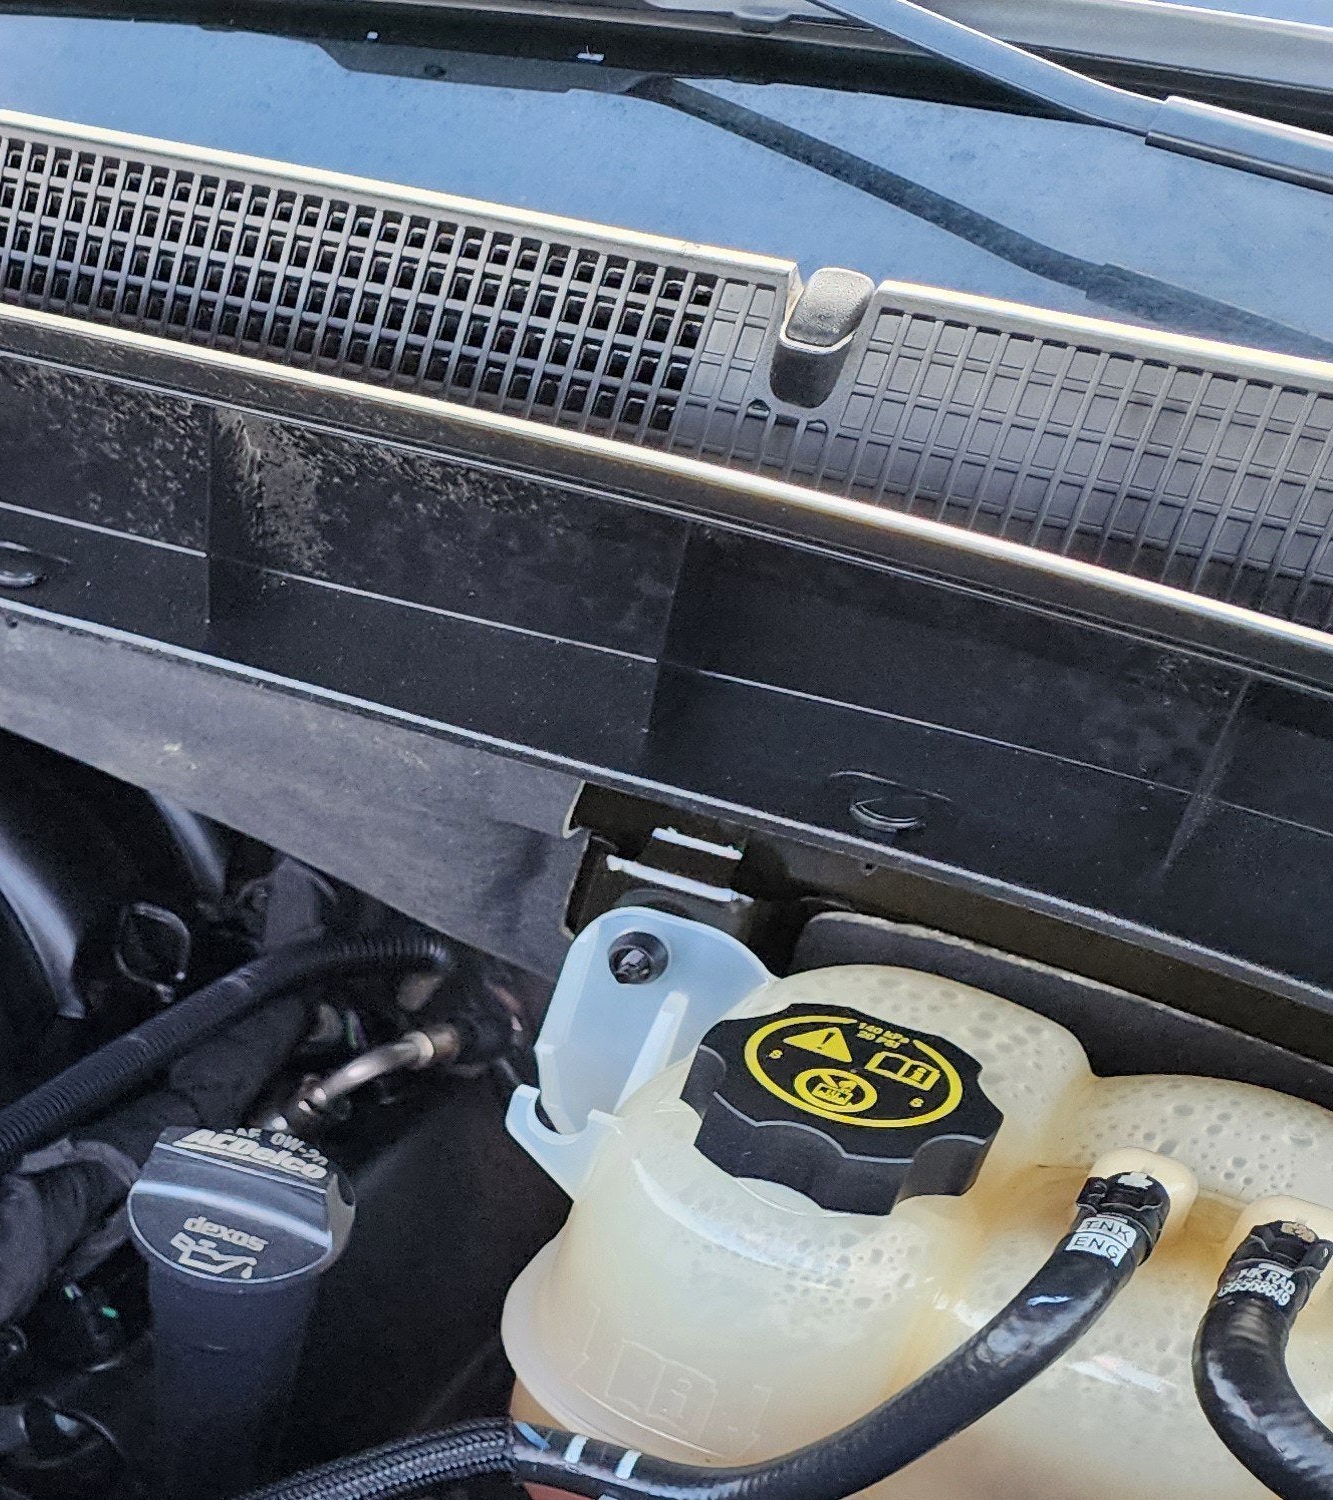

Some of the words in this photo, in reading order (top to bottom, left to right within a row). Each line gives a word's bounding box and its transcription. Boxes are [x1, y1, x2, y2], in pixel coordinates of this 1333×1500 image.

[175, 1128, 328, 1180] ACDelco
[183, 1216, 269, 1252] dexos
[1073, 1236, 1120, 1259] ENG
[1264, 1270, 1296, 1296] RAD
